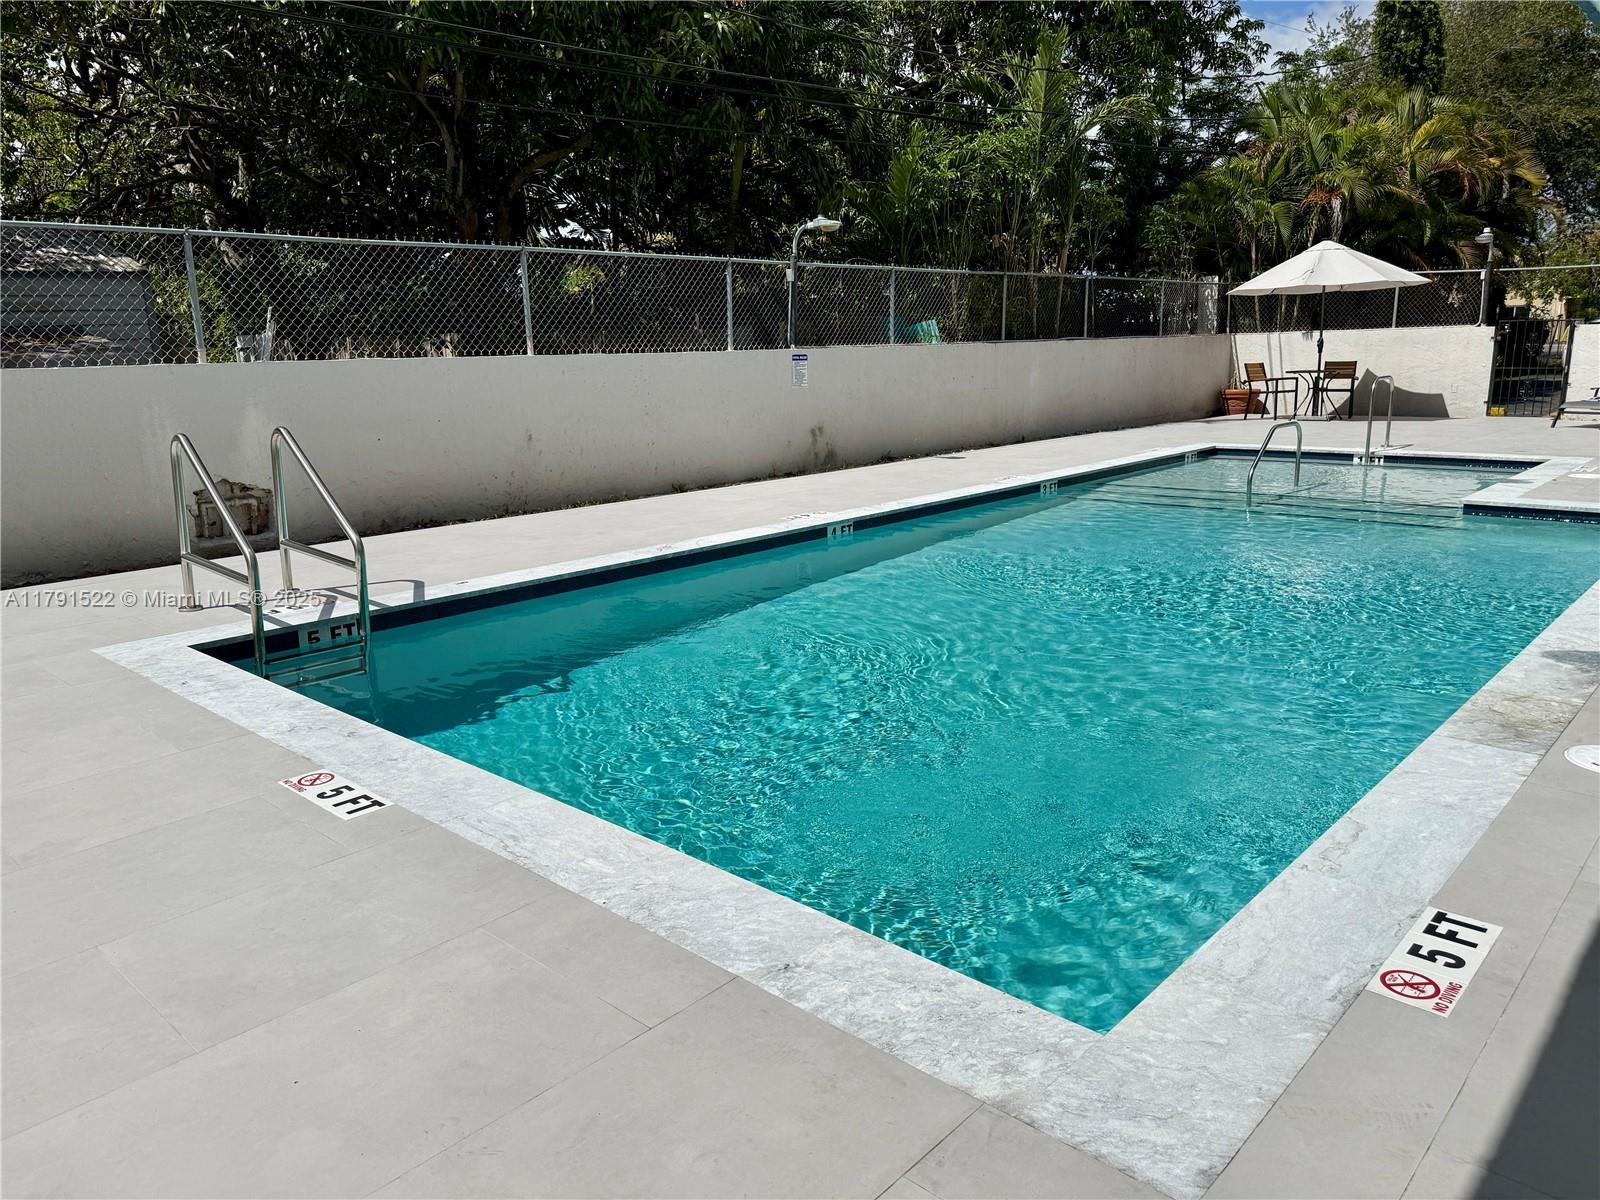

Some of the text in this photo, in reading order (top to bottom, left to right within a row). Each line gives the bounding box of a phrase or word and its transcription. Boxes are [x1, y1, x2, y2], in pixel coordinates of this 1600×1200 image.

[840, 523, 853, 534] FT
[307, 622, 356, 644] 5 FT
[316, 785, 387, 815] 5 FT
[1406, 910, 1488, 969] 5 FT
[1431, 981, 1463, 1014] NO DIVING
